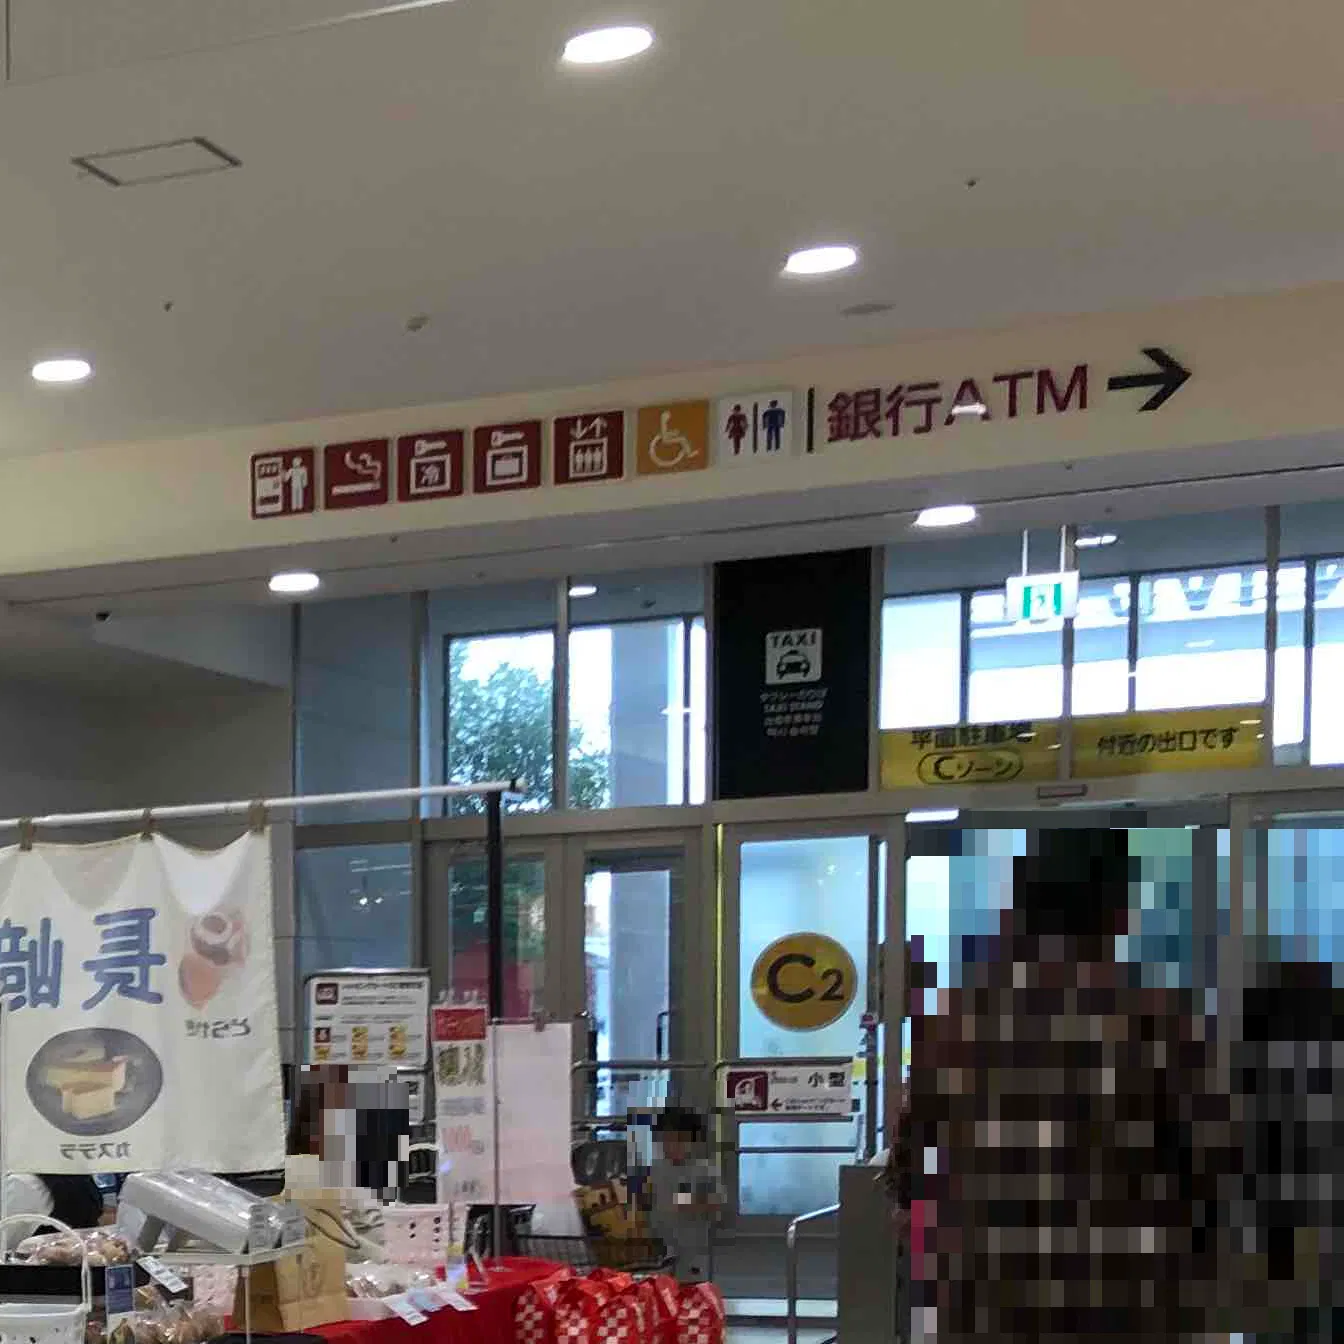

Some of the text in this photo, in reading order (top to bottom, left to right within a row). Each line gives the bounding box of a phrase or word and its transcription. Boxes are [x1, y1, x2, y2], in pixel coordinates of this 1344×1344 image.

[827, 364, 1089, 443] 銀行ATM
[771, 631, 817, 648] TAXI
[1097, 727, 1239, 757] 付近の出口です
[766, 952, 845, 1004] C2
